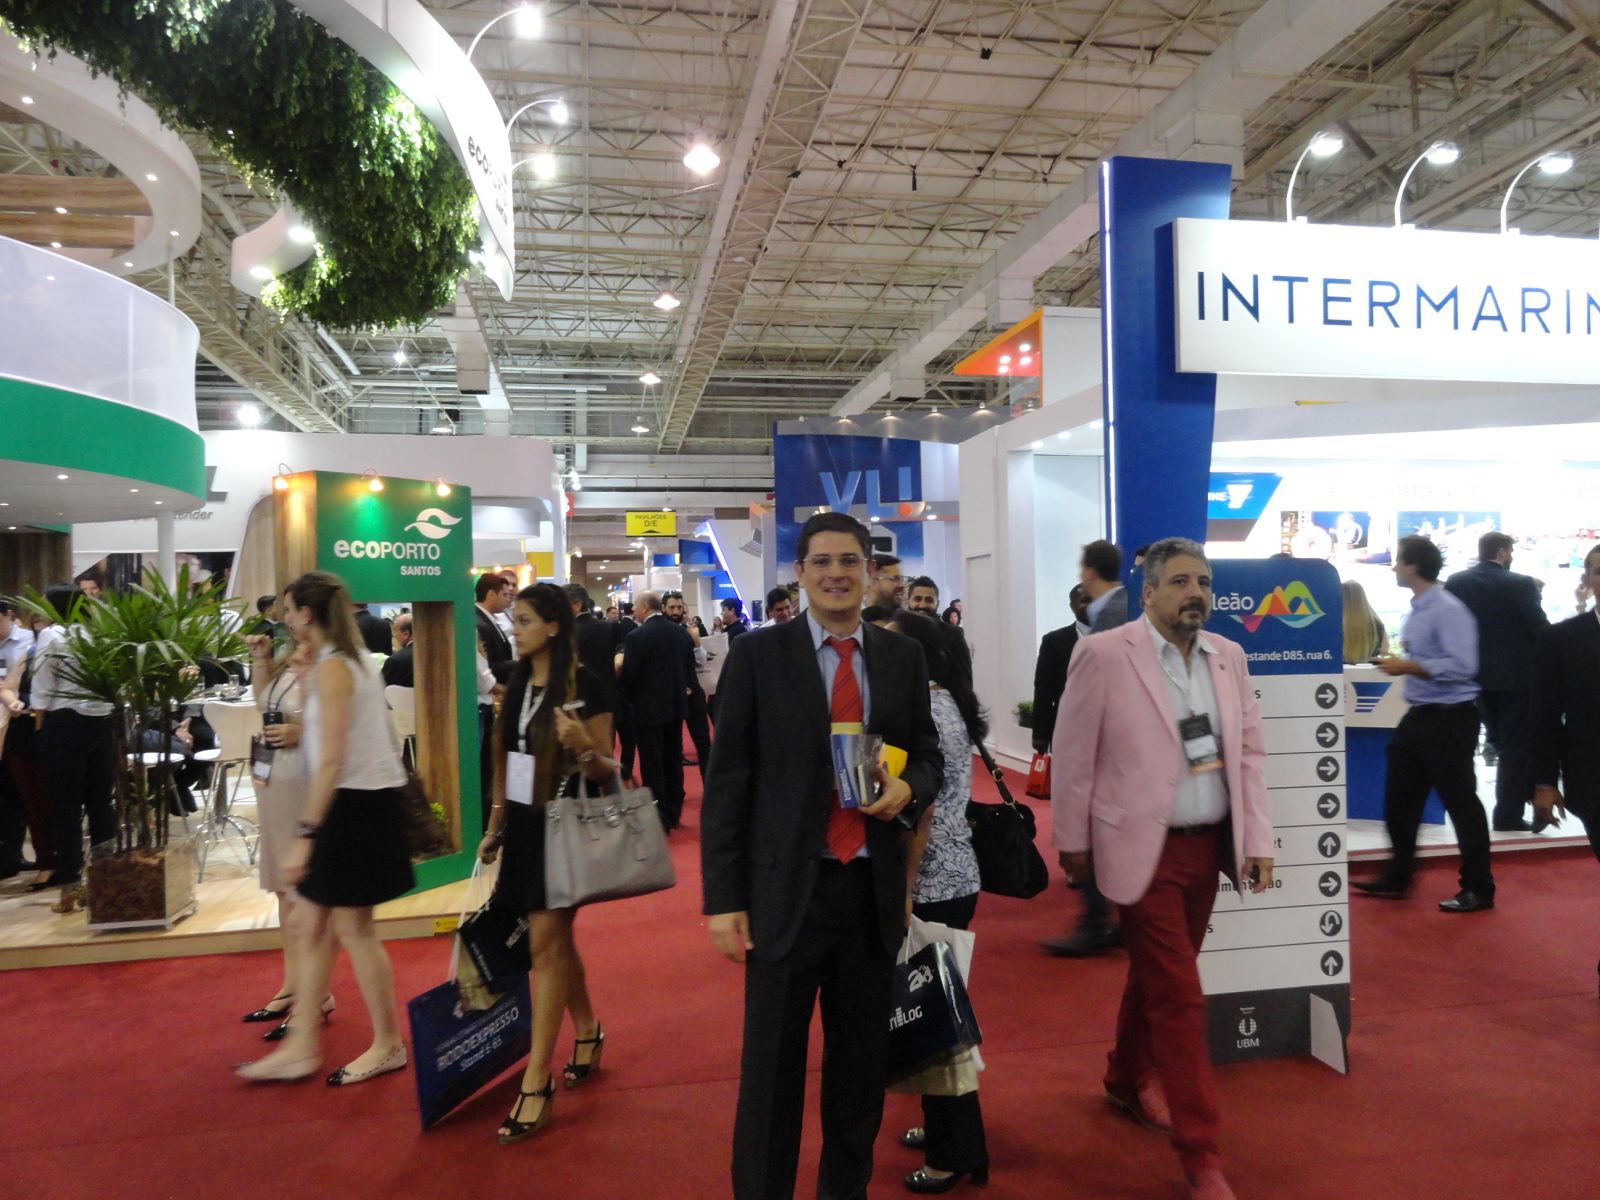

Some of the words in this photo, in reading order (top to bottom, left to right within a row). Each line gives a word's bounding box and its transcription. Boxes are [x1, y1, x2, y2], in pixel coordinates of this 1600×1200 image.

[400, 565, 442, 576] SANTOS
[1282, 650, 1305, 661] D85,
[1323, 650, 1333, 660] 6.
[1236, 1038, 1259, 1048] UBM
